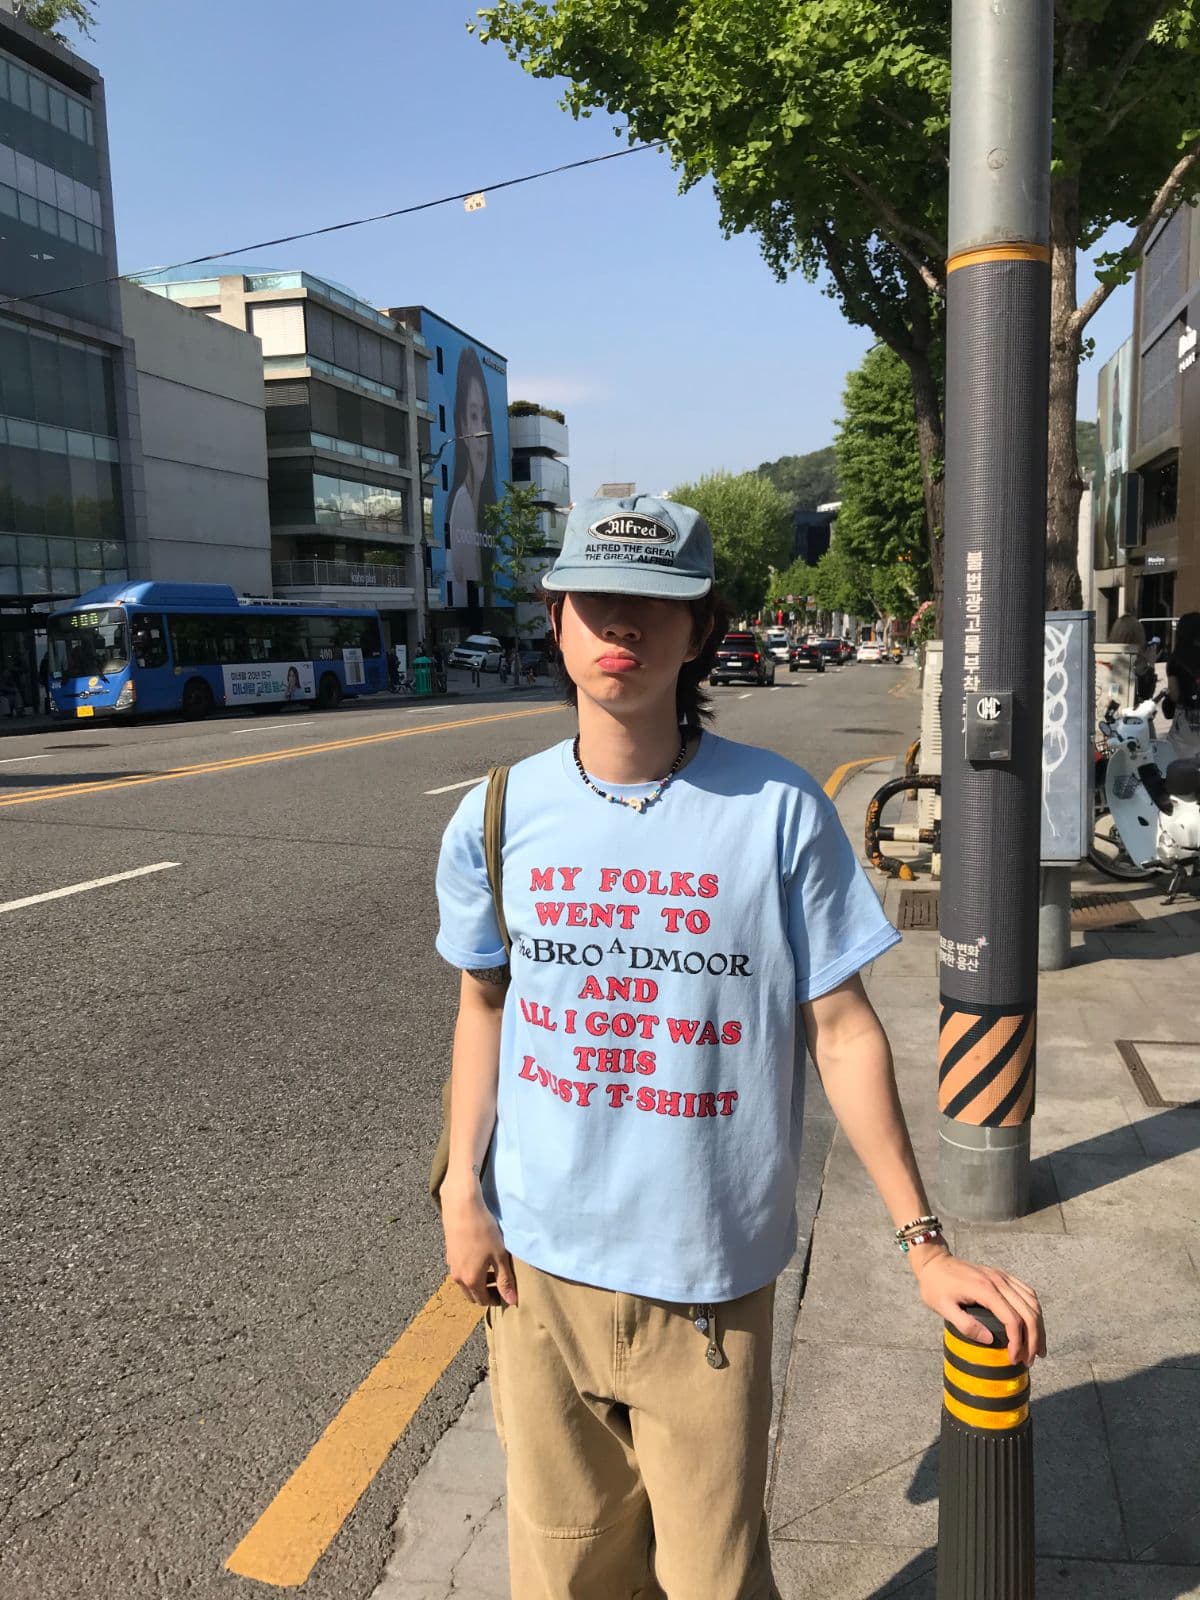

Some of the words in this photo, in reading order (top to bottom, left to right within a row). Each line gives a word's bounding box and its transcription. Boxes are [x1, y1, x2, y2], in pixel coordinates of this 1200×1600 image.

[605, 519, 657, 537] Alfred
[585, 543, 621, 553] ALFRED
[623, 544, 643, 553] THE
[645, 546, 676, 559] GREAT
[585, 553, 602, 561] THE
[603, 553, 635, 561] GREAT
[637, 554, 674, 567] ALFRED
[232, 682, 256, 696] 미네랄
[530, 867, 582, 892] MY
[599, 868, 719, 898] FOLKS
[535, 902, 640, 929] WENT
[661, 908, 711, 935] TO
[956, 942, 980, 957] 변화
[956, 957, 980, 972] 용산
[578, 975, 659, 1003] AND
[565, 1009, 578, 1034] I
[585, 1012, 659, 1039] GOT
[667, 1017, 742, 1045] WAS
[573, 1046, 656, 1075] THIS
[606, 1084, 738, 1118] T-SHIRT
